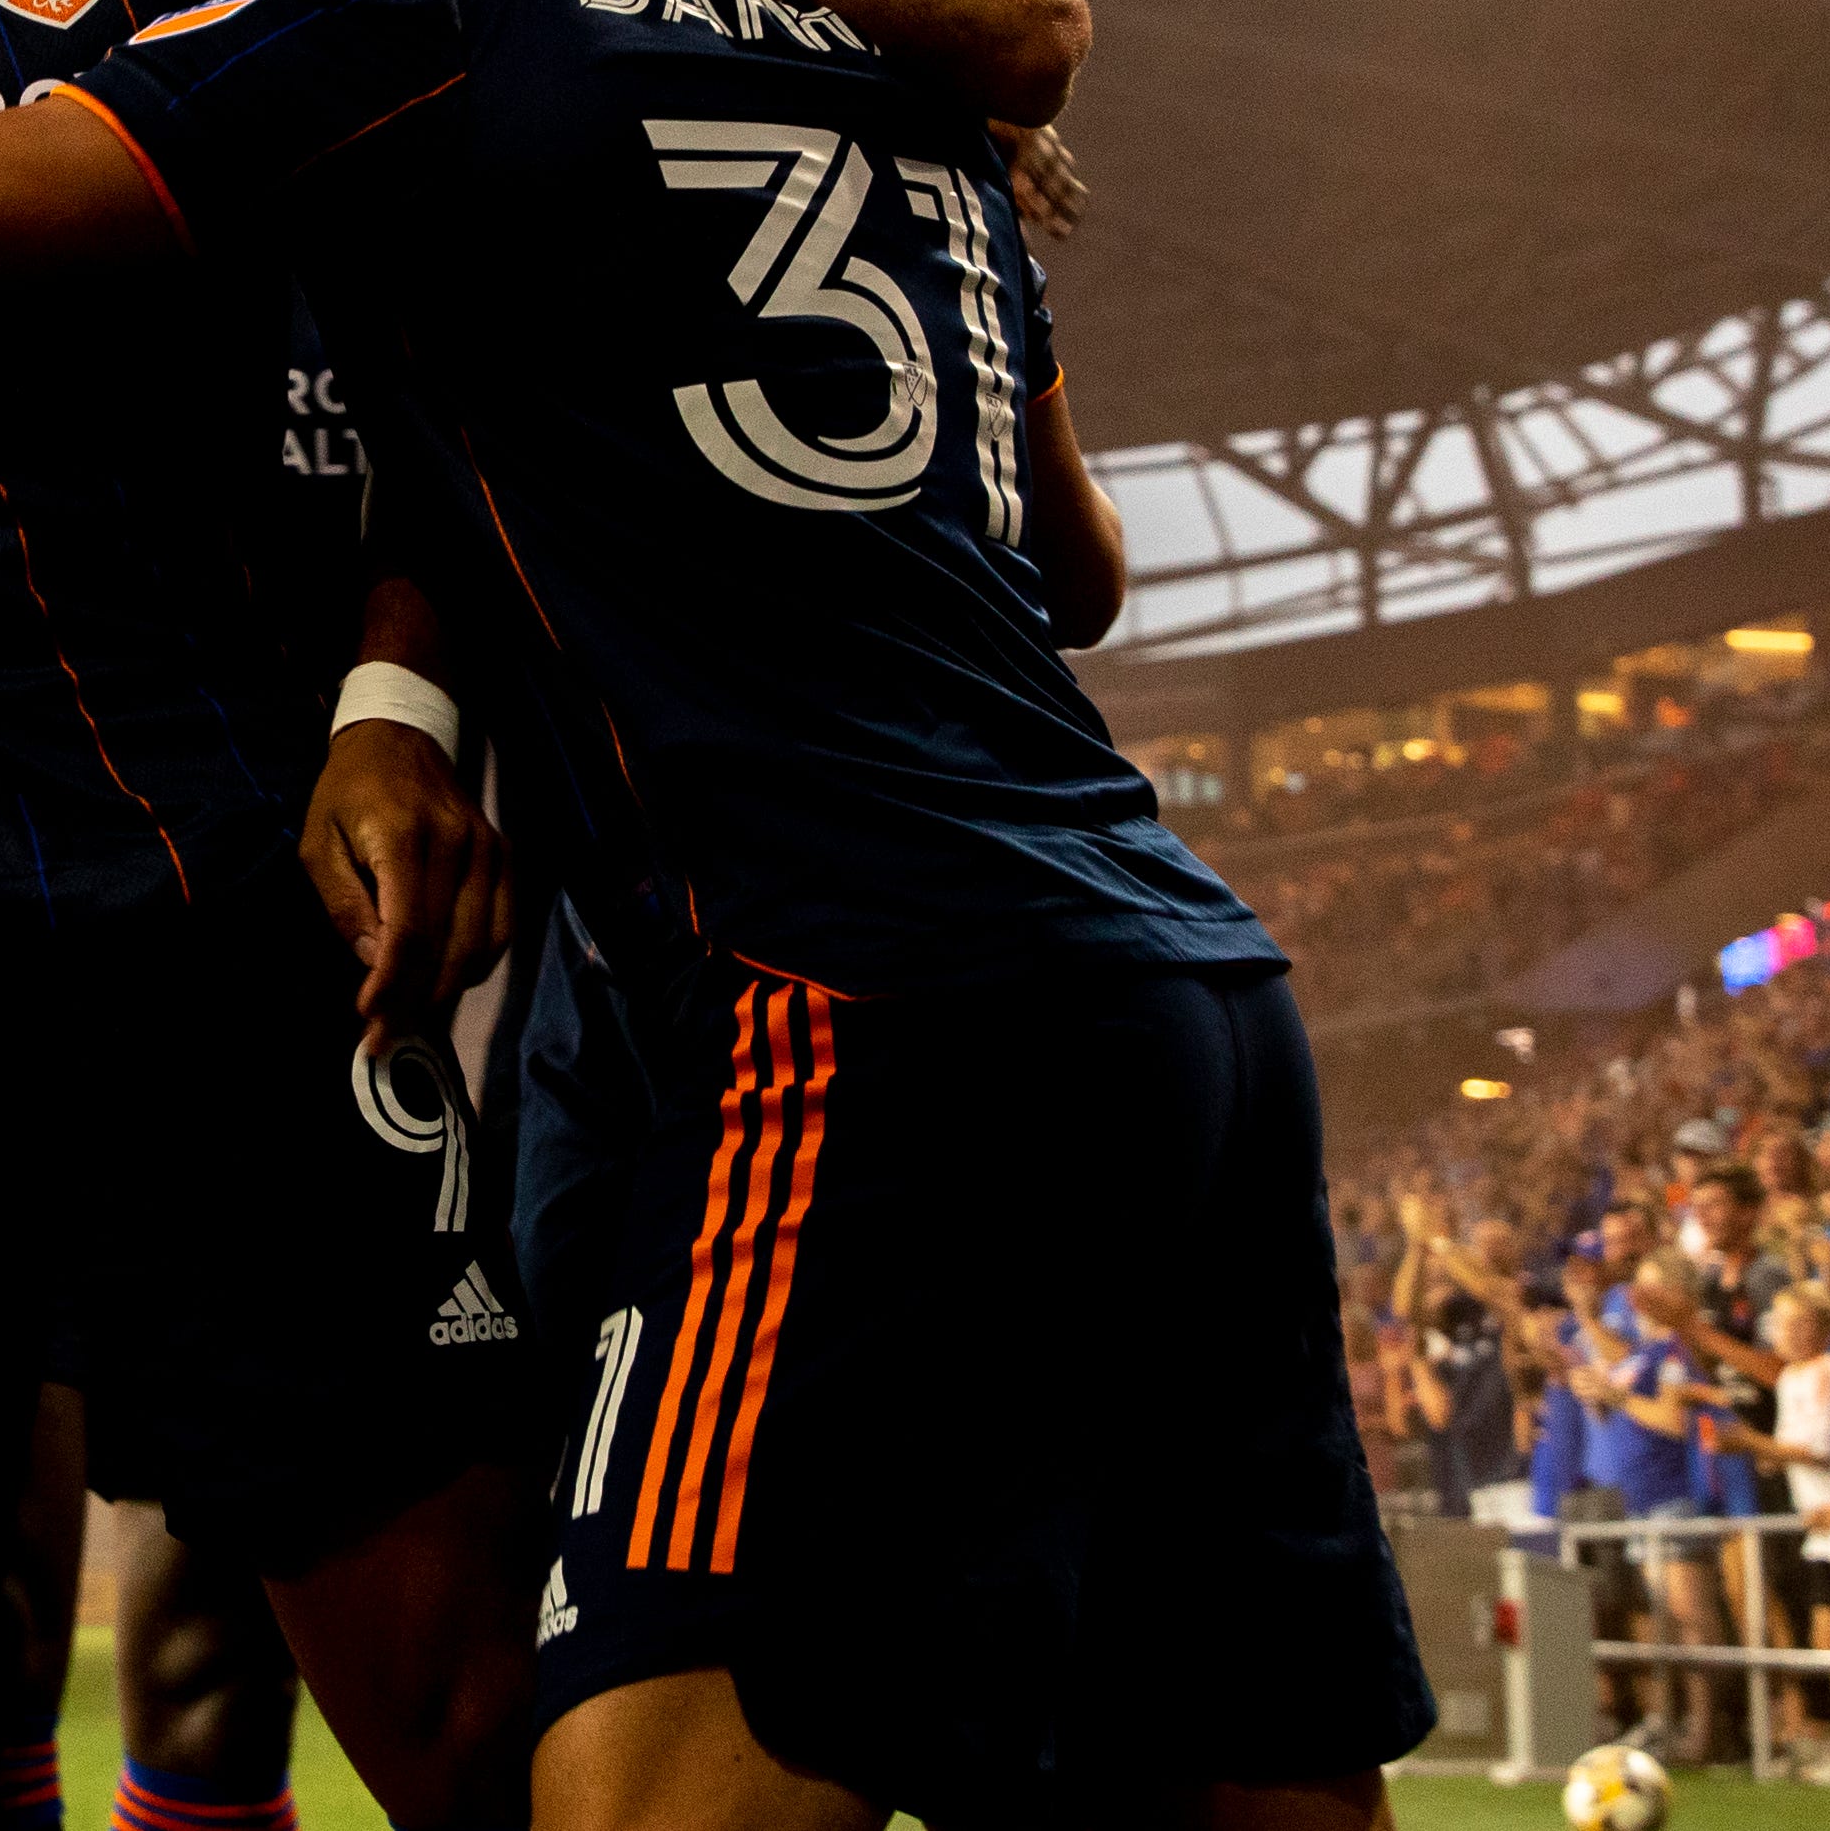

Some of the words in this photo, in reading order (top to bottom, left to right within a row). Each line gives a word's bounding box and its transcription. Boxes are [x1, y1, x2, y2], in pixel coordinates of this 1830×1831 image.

[641, 119, 1024, 549] 31
[351, 1031, 470, 1233] 9
[429, 1312, 519, 1347] adidas
